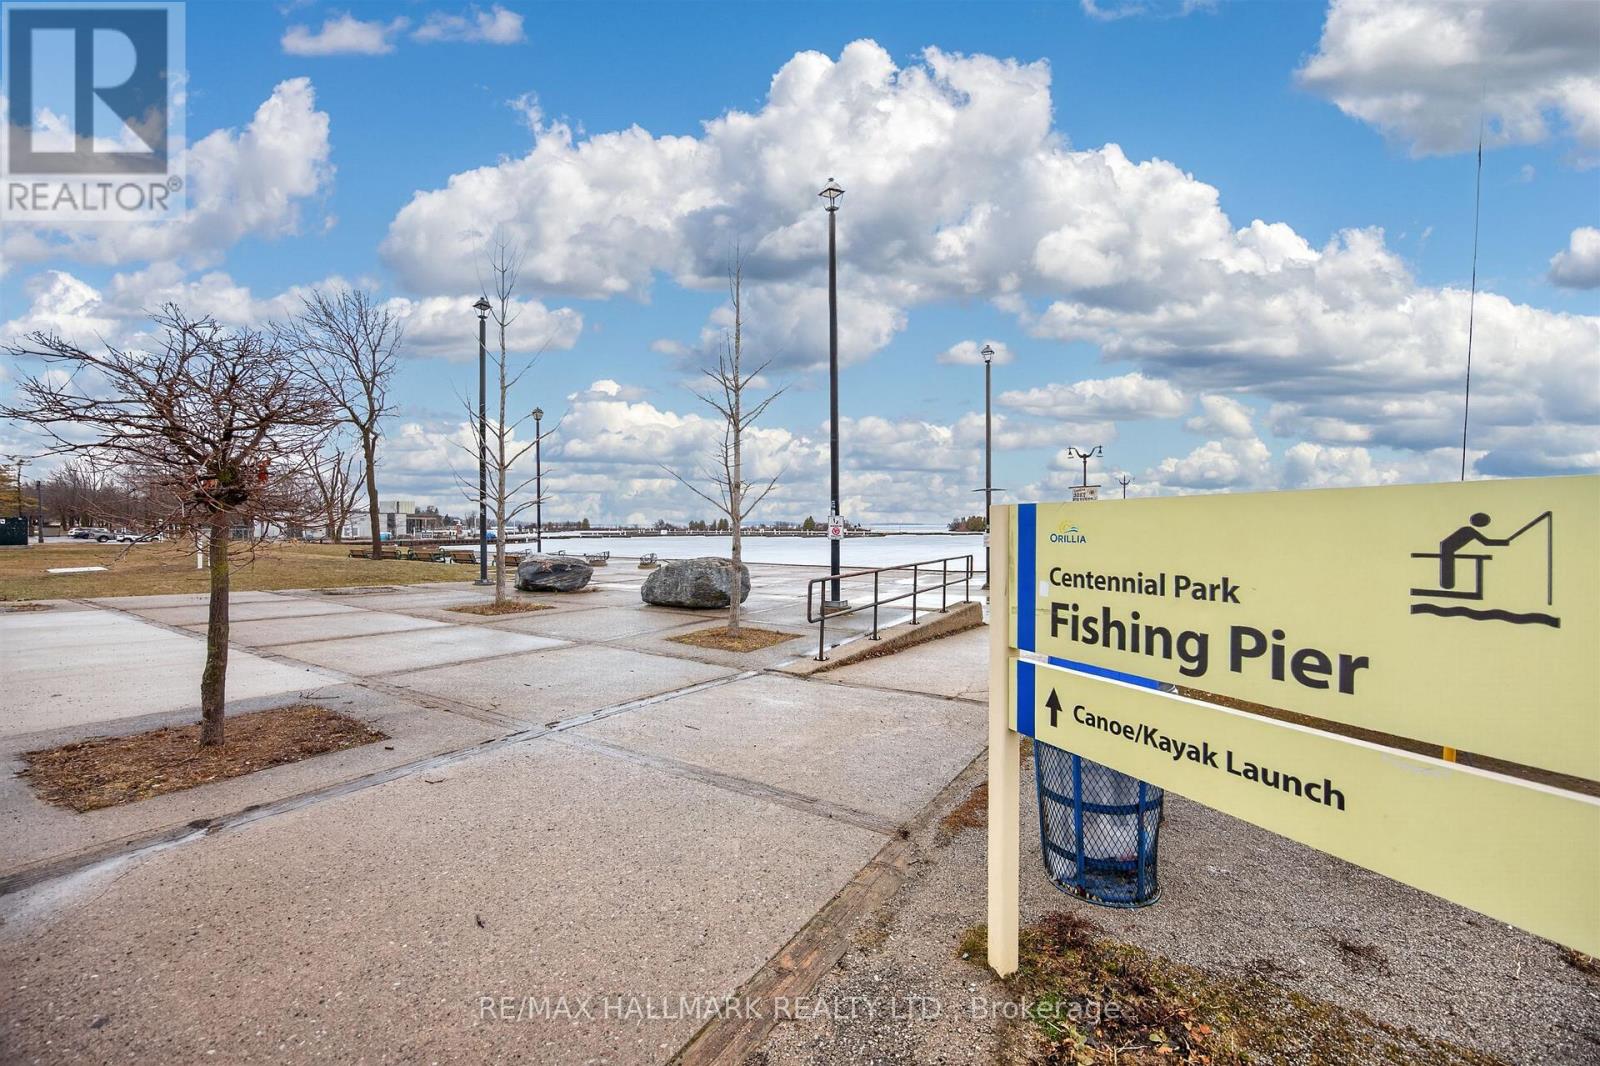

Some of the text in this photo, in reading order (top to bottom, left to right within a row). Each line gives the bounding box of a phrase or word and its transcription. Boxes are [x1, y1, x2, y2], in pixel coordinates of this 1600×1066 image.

[1049, 533, 1087, 544] ORILLIA
[1050, 567, 1241, 604] Centennial Park
[1051, 601, 1370, 695] Fishing Pier
[1073, 705, 1345, 811] Canoe/Kayak Launch
